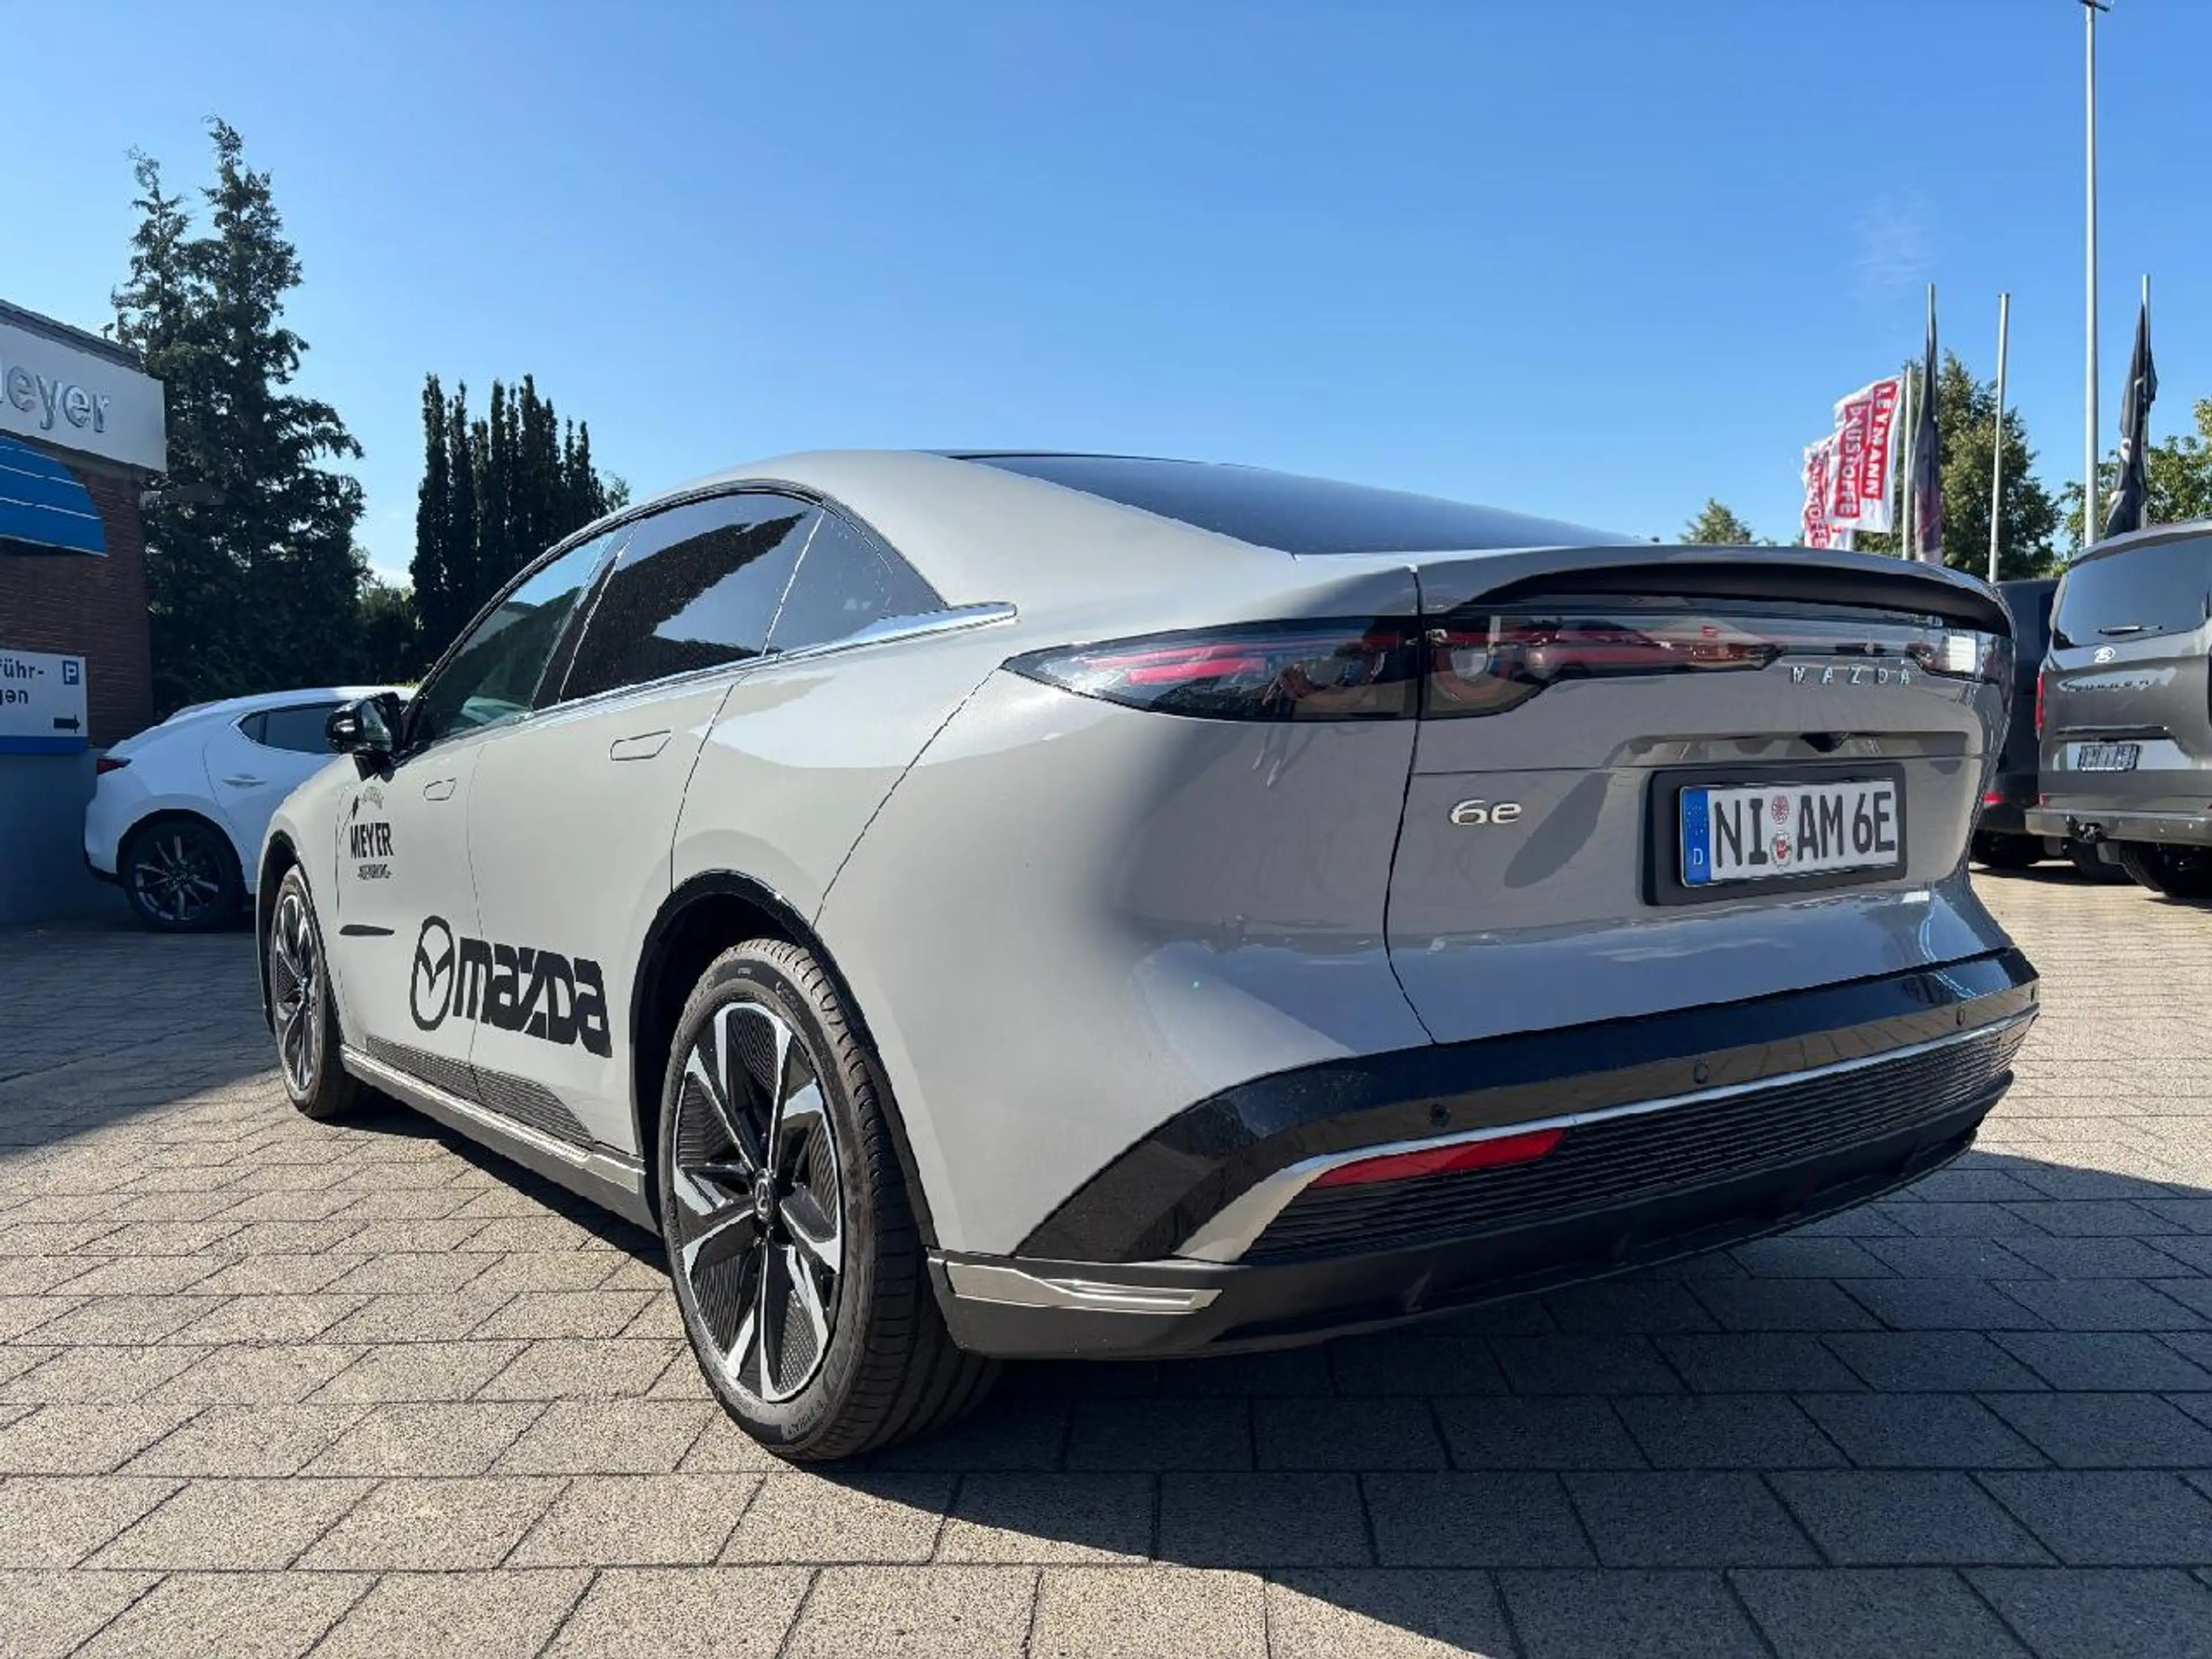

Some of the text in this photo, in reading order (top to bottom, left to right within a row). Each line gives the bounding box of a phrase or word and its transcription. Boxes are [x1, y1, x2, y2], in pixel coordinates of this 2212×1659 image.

[0, 363, 111, 433] eyer
[0, 658, 44, 679] ühr-
[1793, 666, 1911, 685] MAZDA
[0, 689, 29, 706] en
[1450, 798, 1522, 825] 6e
[350, 822, 395, 859] MEYER
[1714, 798, 1767, 868] NI
[1693, 847, 1703, 865] D
